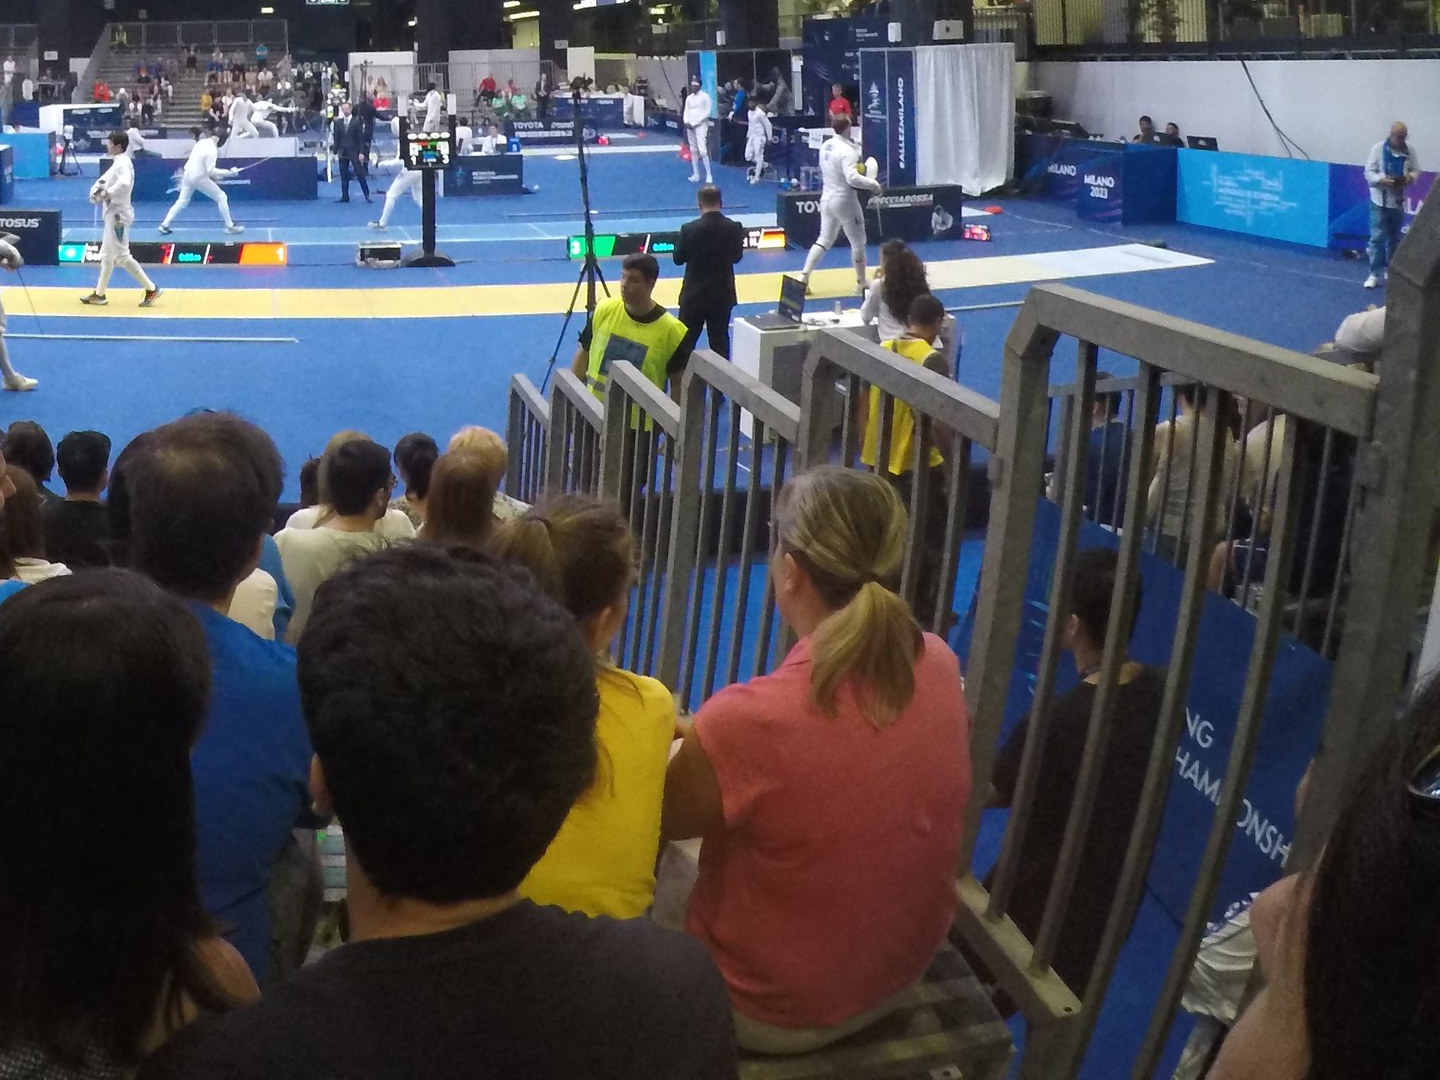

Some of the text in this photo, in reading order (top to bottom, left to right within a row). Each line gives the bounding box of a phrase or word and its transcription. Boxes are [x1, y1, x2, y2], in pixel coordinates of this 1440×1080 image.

[513, 121, 544, 130] TOYOTA
[1083, 174, 1115, 188] MILANO
[1090, 186, 1109, 199] 2023
[796, 200, 822, 214] TOY
